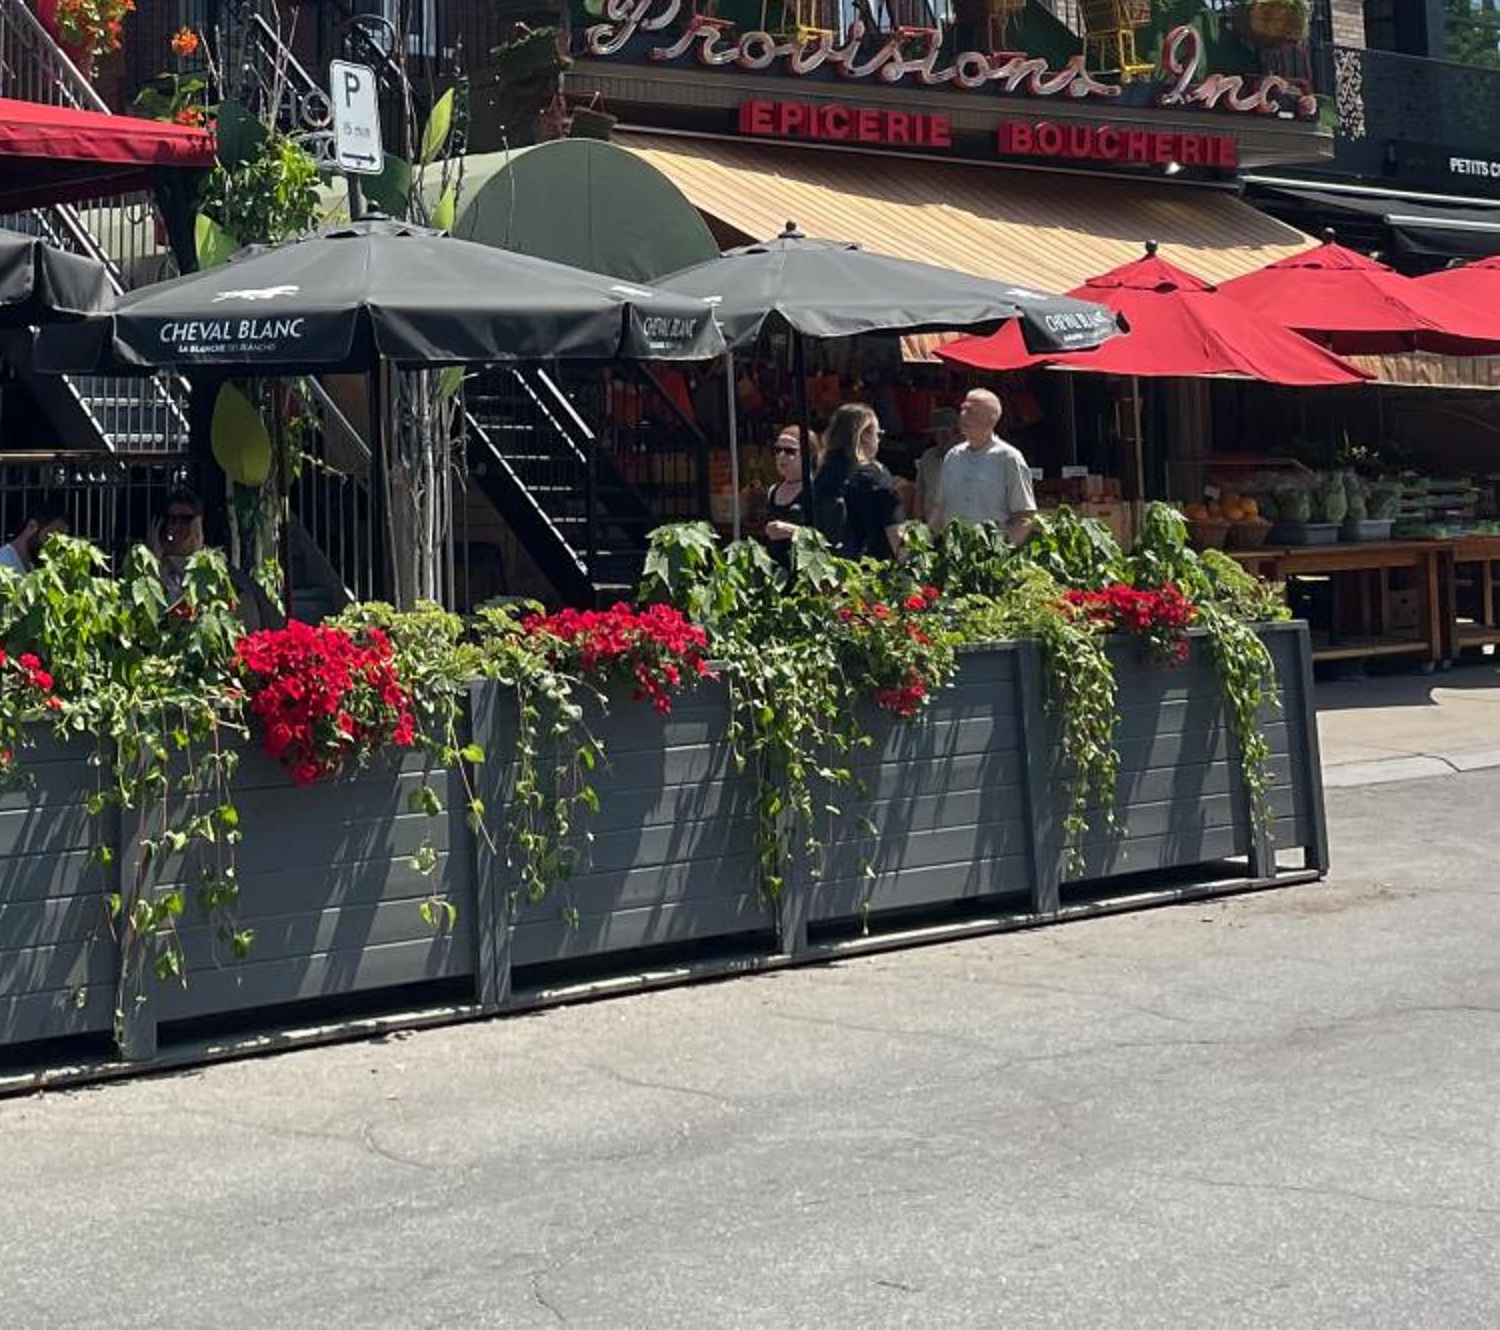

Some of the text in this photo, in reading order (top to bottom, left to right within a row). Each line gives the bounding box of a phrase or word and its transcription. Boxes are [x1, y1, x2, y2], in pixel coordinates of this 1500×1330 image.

[344, 71, 361, 108] P
[743, 100, 1239, 166] EPICERIE BOUCHERIE
[1449, 157, 1489, 177] PETITS
[160, 318, 305, 343] CHEVAL BLANC
